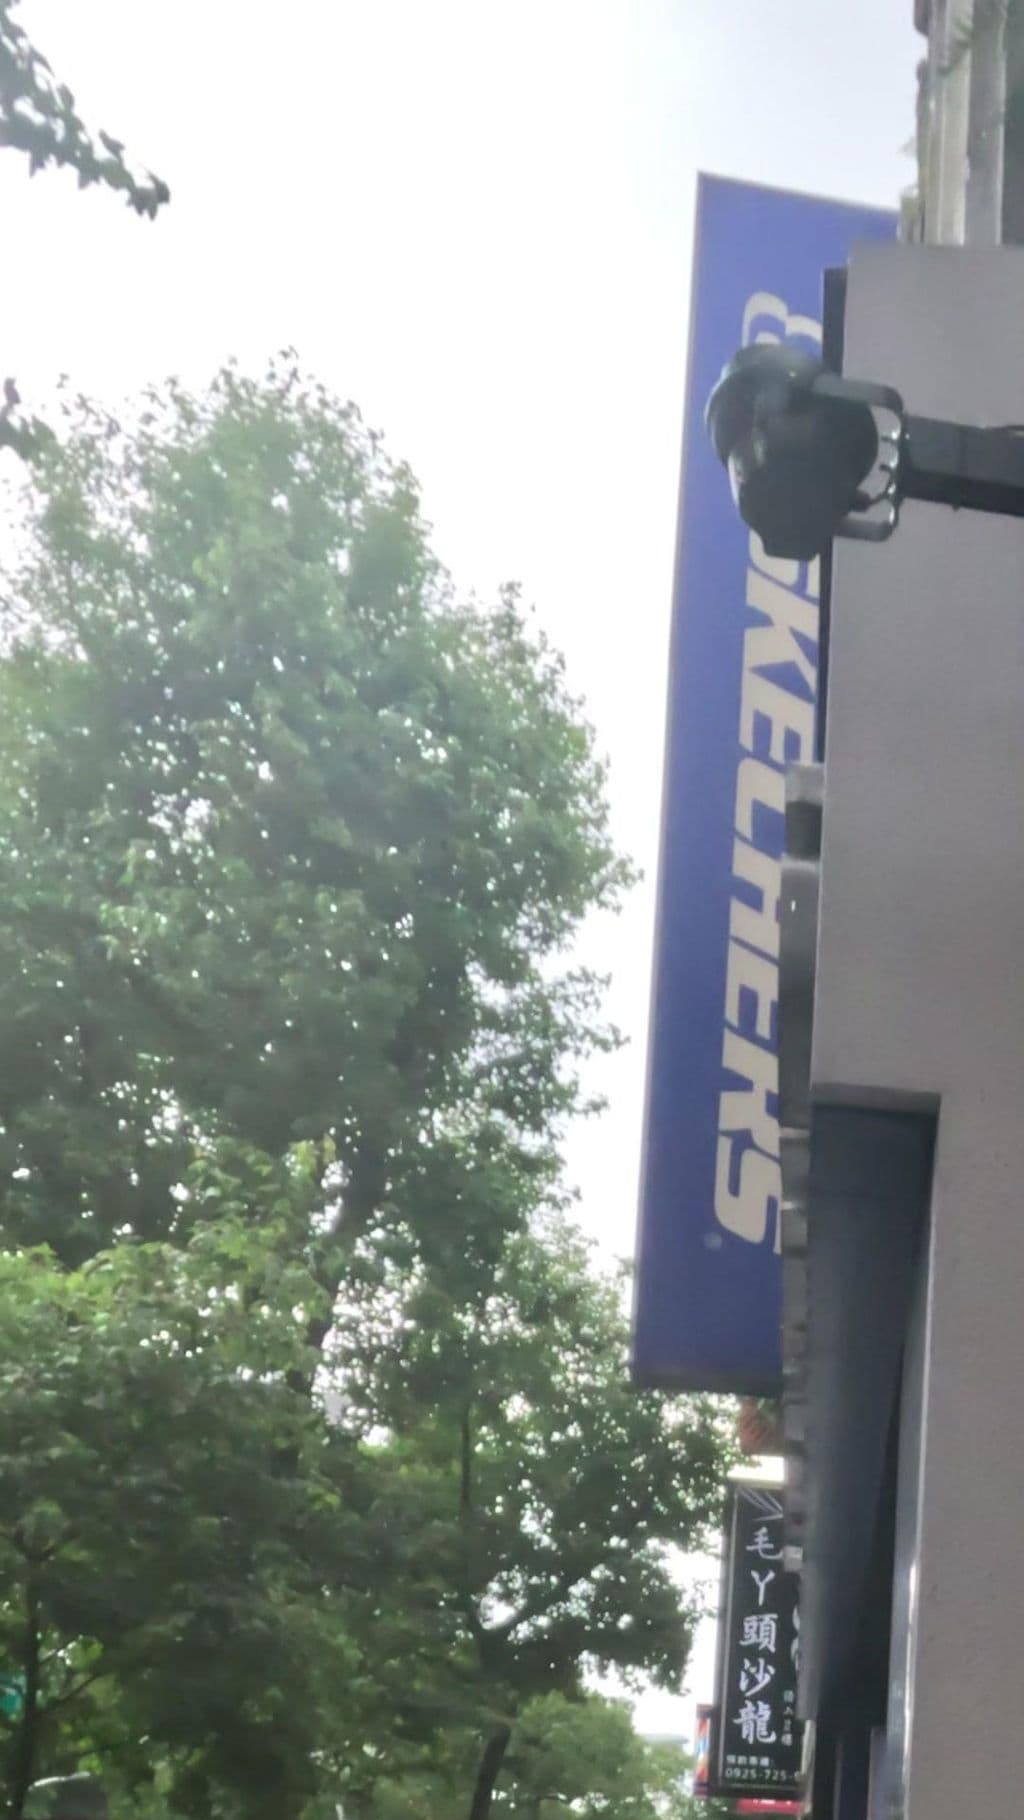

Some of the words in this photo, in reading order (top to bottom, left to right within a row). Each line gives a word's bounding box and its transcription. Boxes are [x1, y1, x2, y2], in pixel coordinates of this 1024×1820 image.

[732, 1526, 784, 1744] 毛丫頭沙龍
